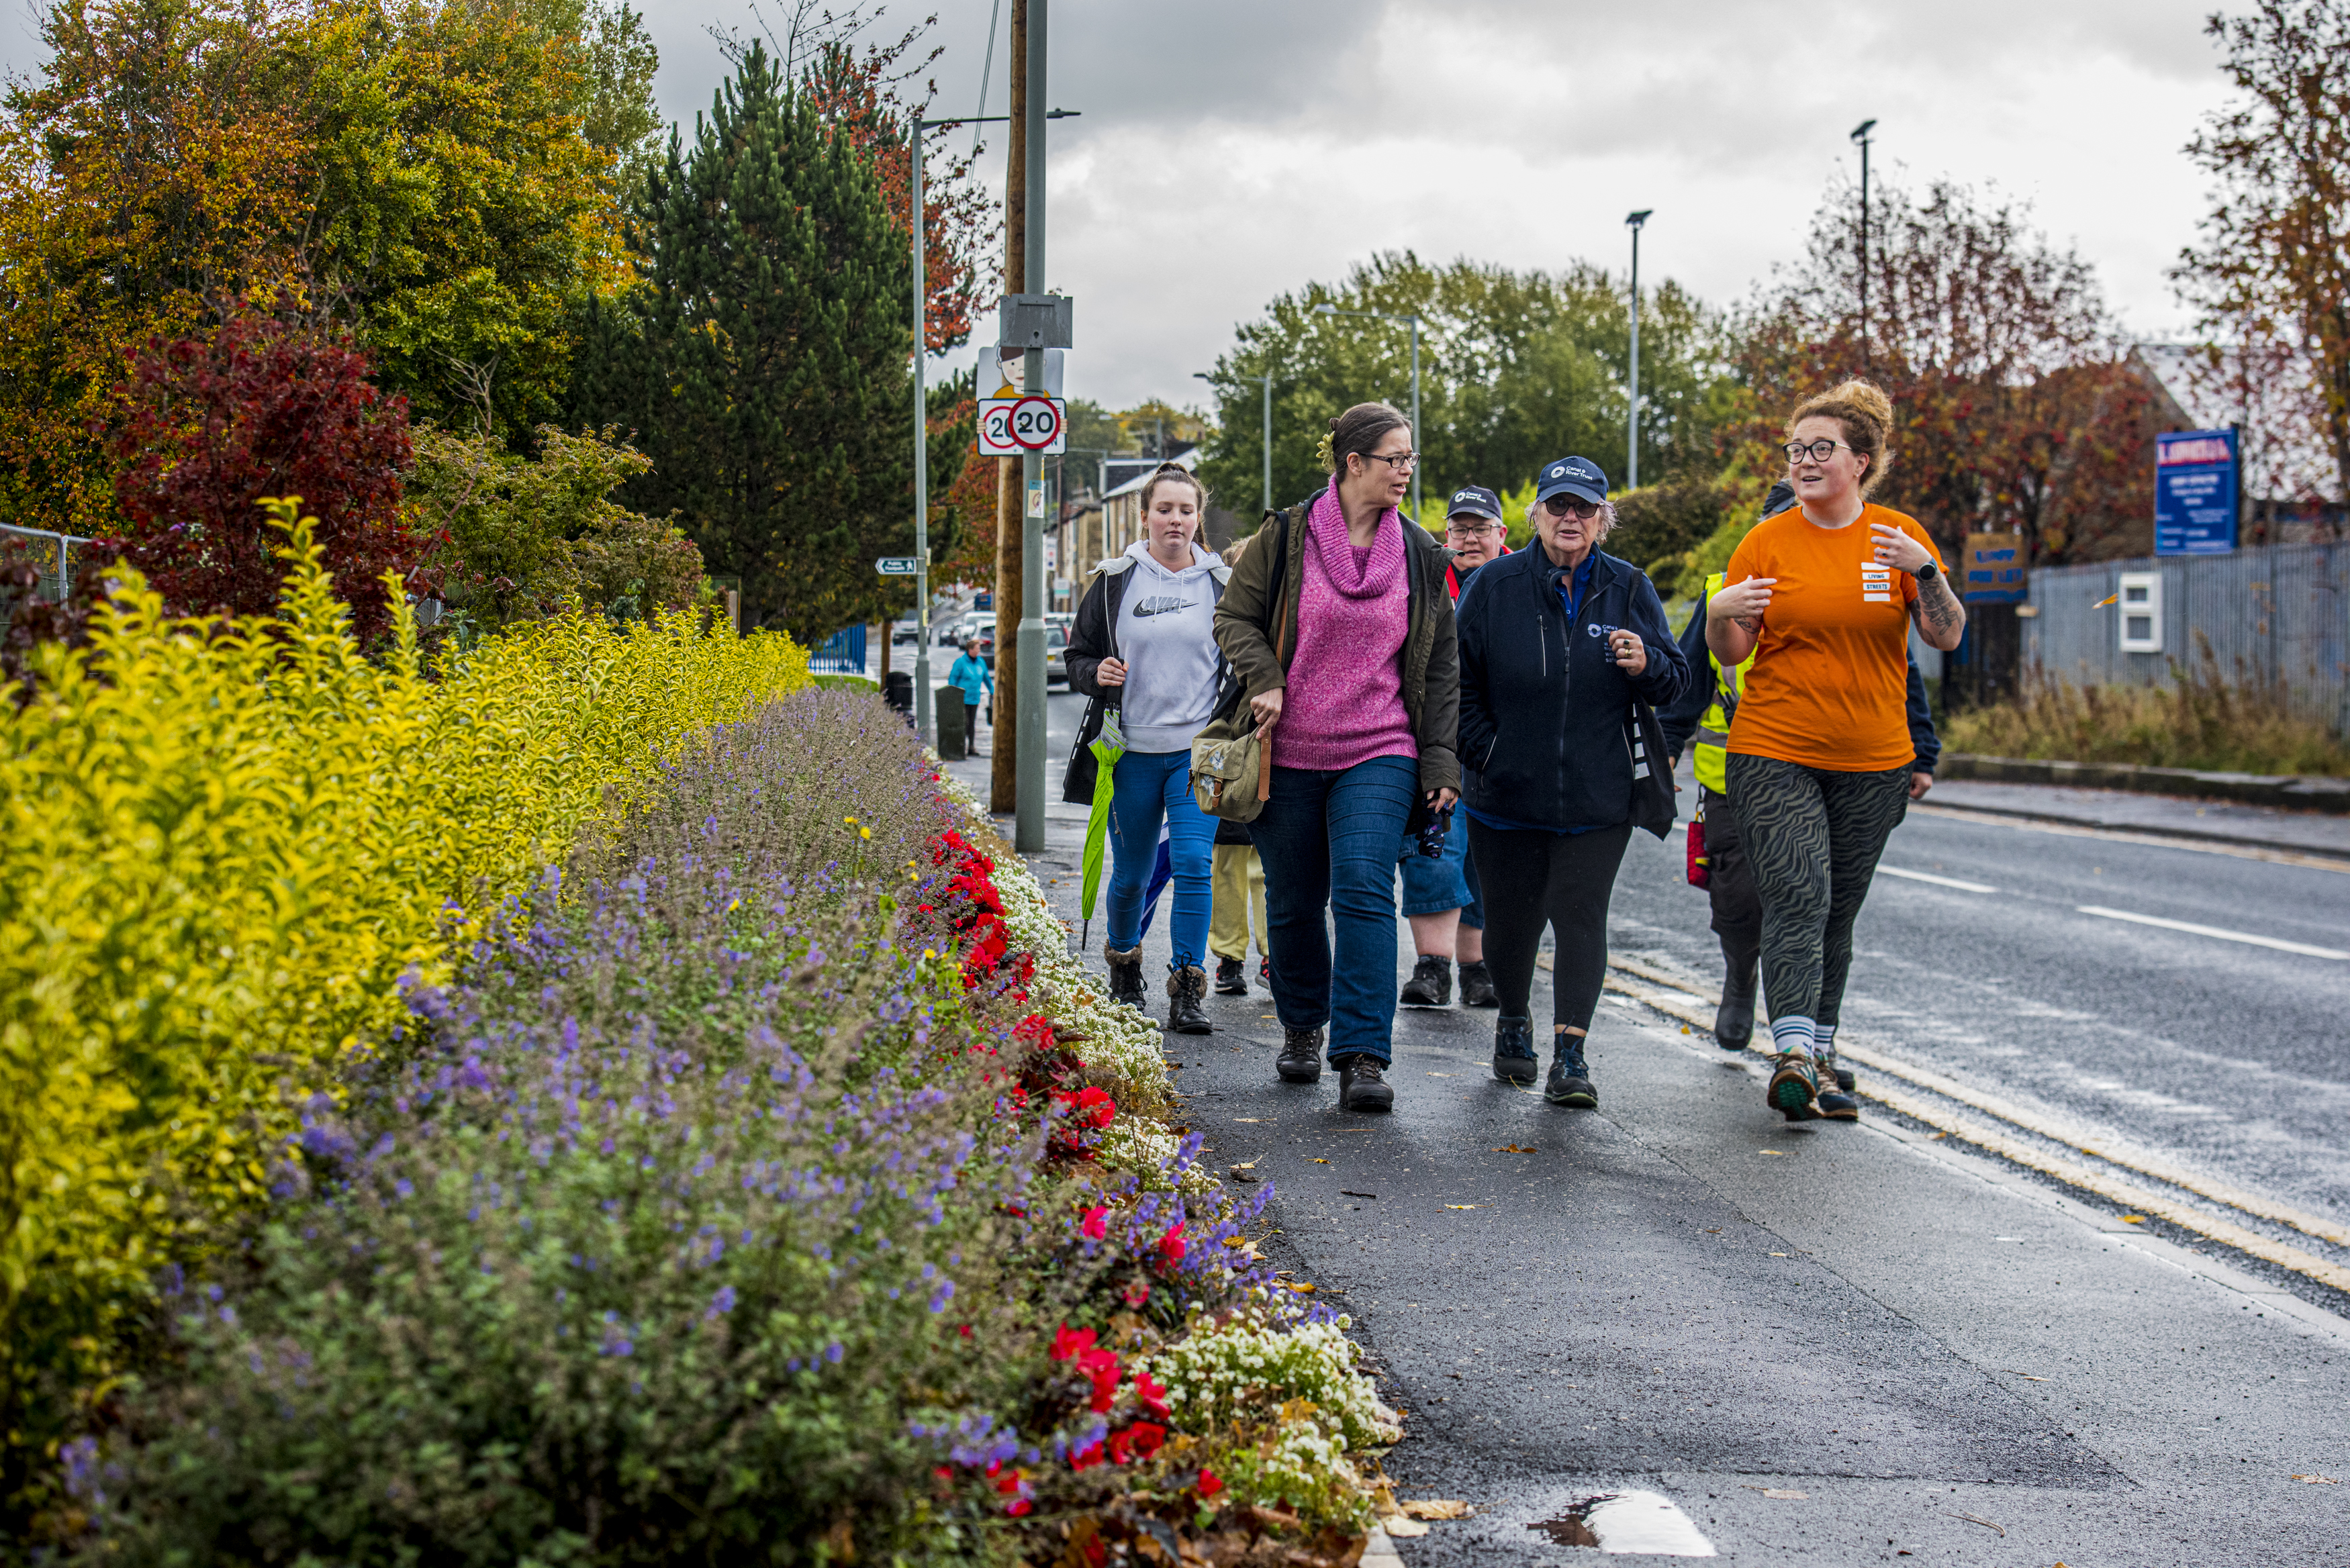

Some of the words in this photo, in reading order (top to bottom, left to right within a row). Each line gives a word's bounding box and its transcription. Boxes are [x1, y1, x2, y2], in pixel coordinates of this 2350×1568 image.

[1017, 411, 1053, 434] 20
[1580, 472, 1593, 481] Trust
[1143, 596, 1187, 614] NIKE
